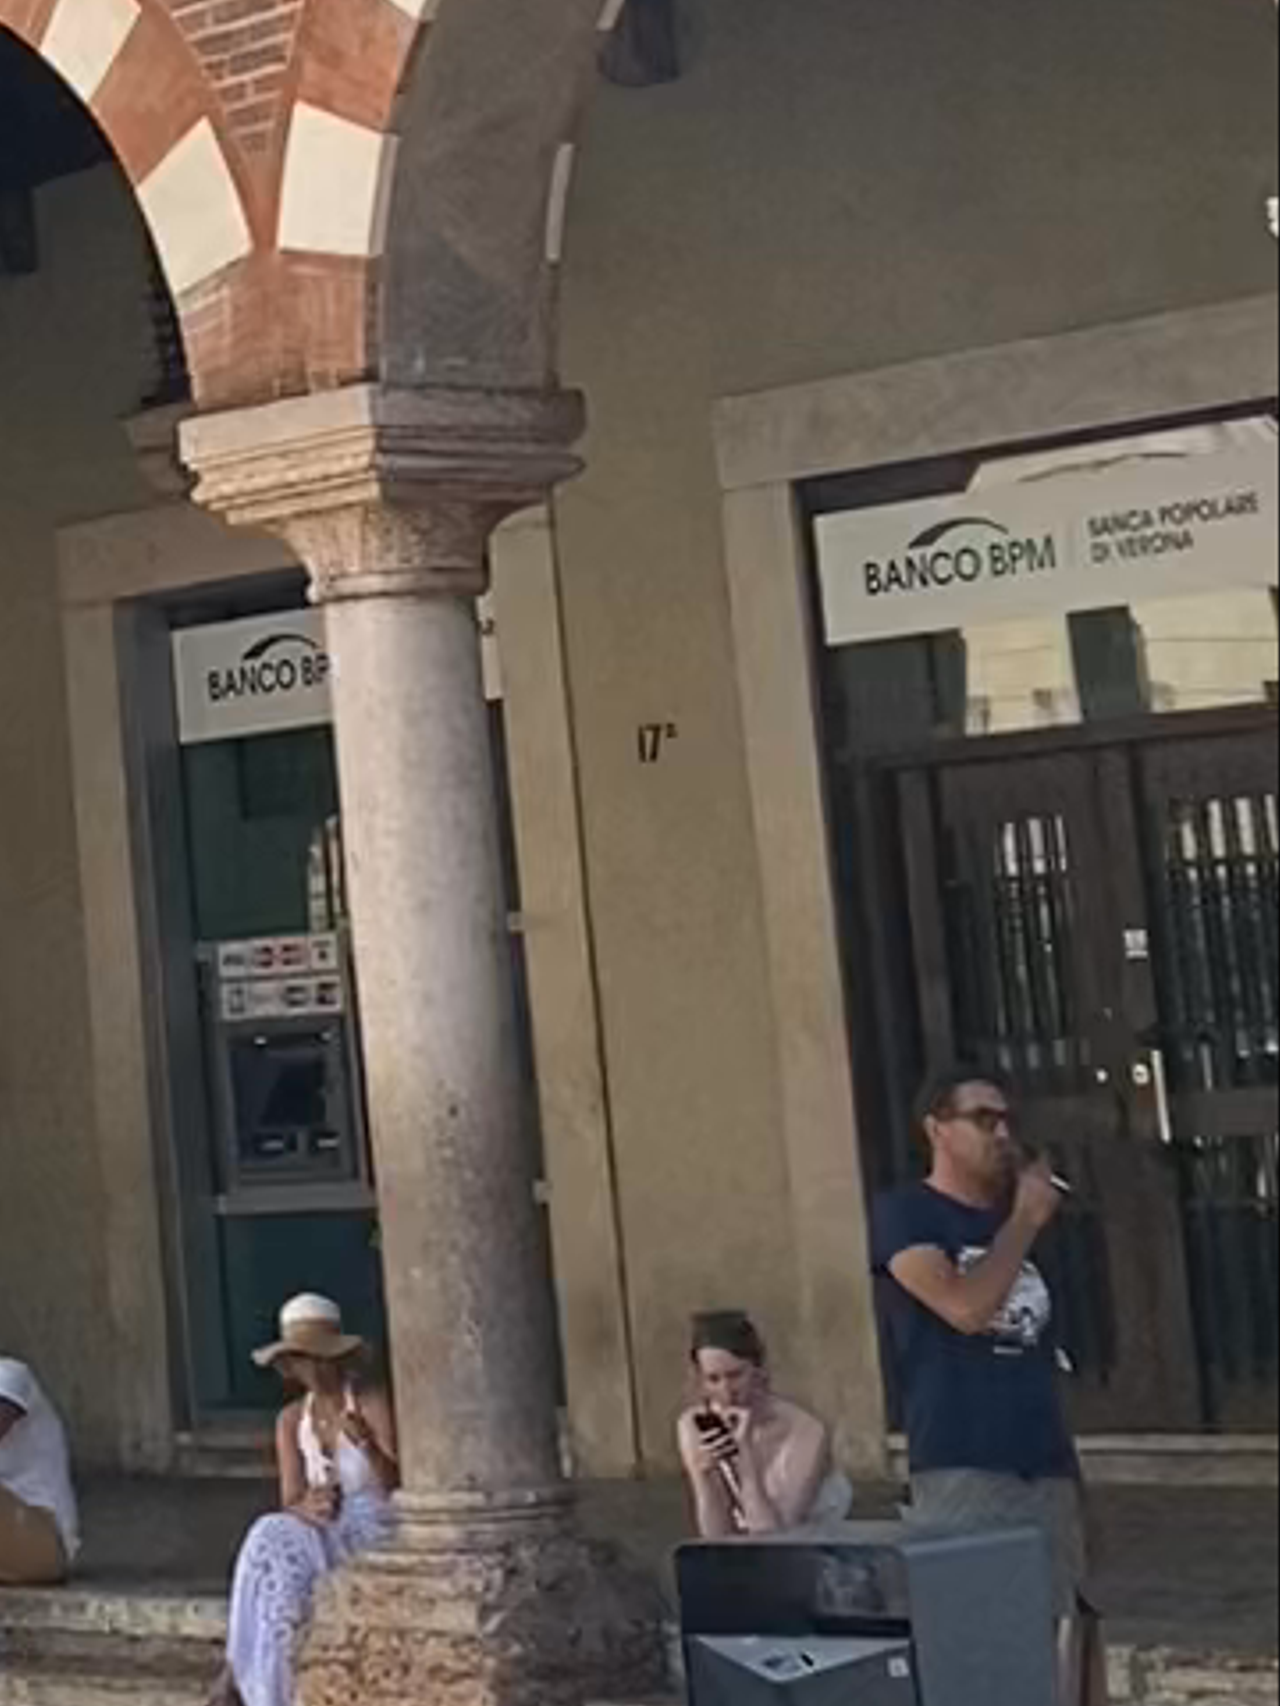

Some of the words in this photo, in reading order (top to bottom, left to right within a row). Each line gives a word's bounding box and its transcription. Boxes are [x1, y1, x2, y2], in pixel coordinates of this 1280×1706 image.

[1088, 509, 1154, 536] BANCA
[864, 547, 981, 595] BANCO
[989, 535, 1056, 576] BPM
[207, 659, 296, 701] BANCO
[301, 652, 330, 687] BP
